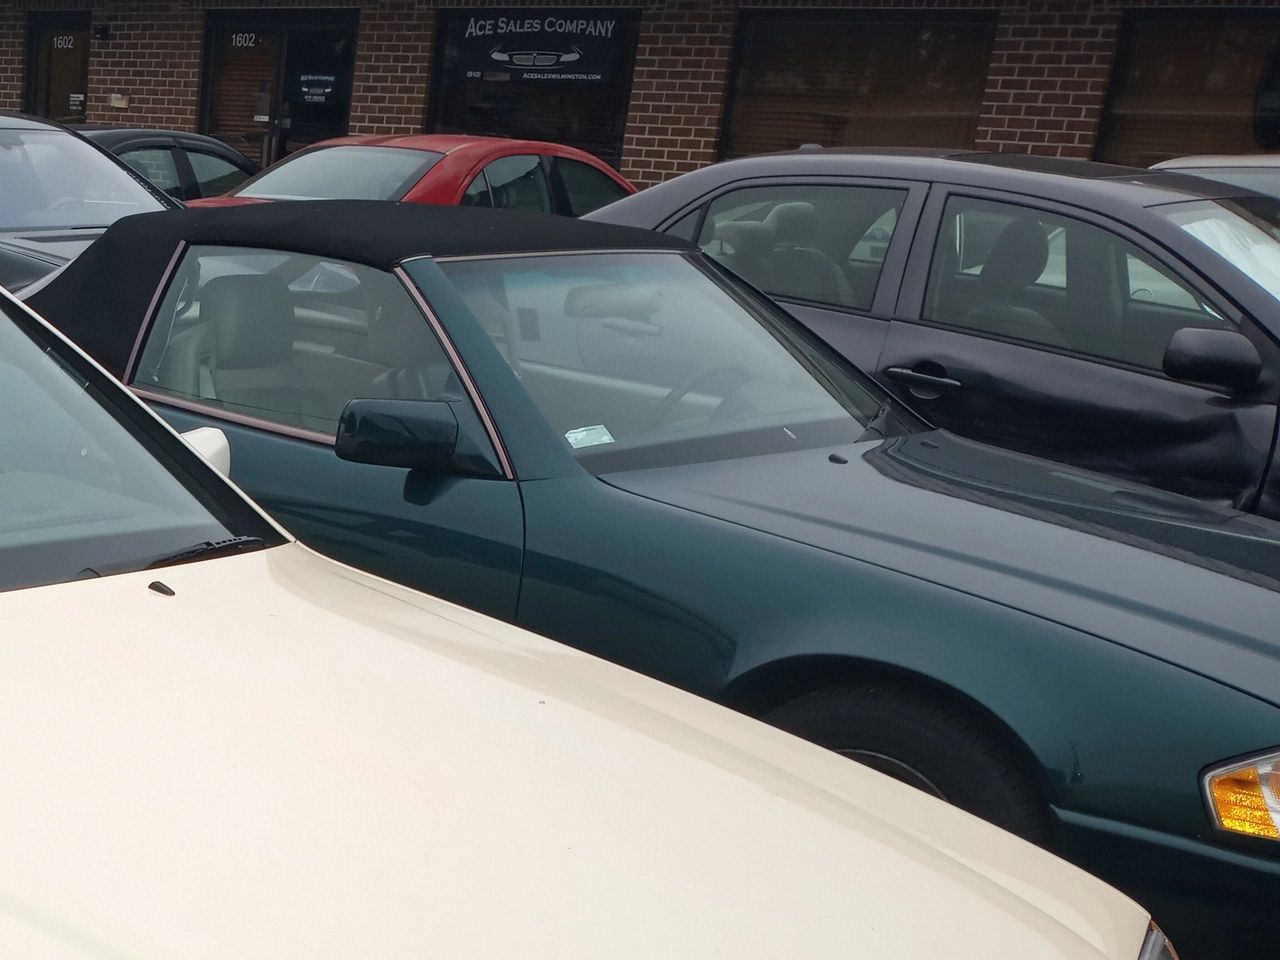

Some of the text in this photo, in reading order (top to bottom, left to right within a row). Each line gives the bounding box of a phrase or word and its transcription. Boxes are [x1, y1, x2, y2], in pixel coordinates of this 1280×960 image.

[465, 17, 616, 38] ACE SALES COMPANY
[53, 36, 73, 48] 1602
[232, 33, 255, 47] 1602
